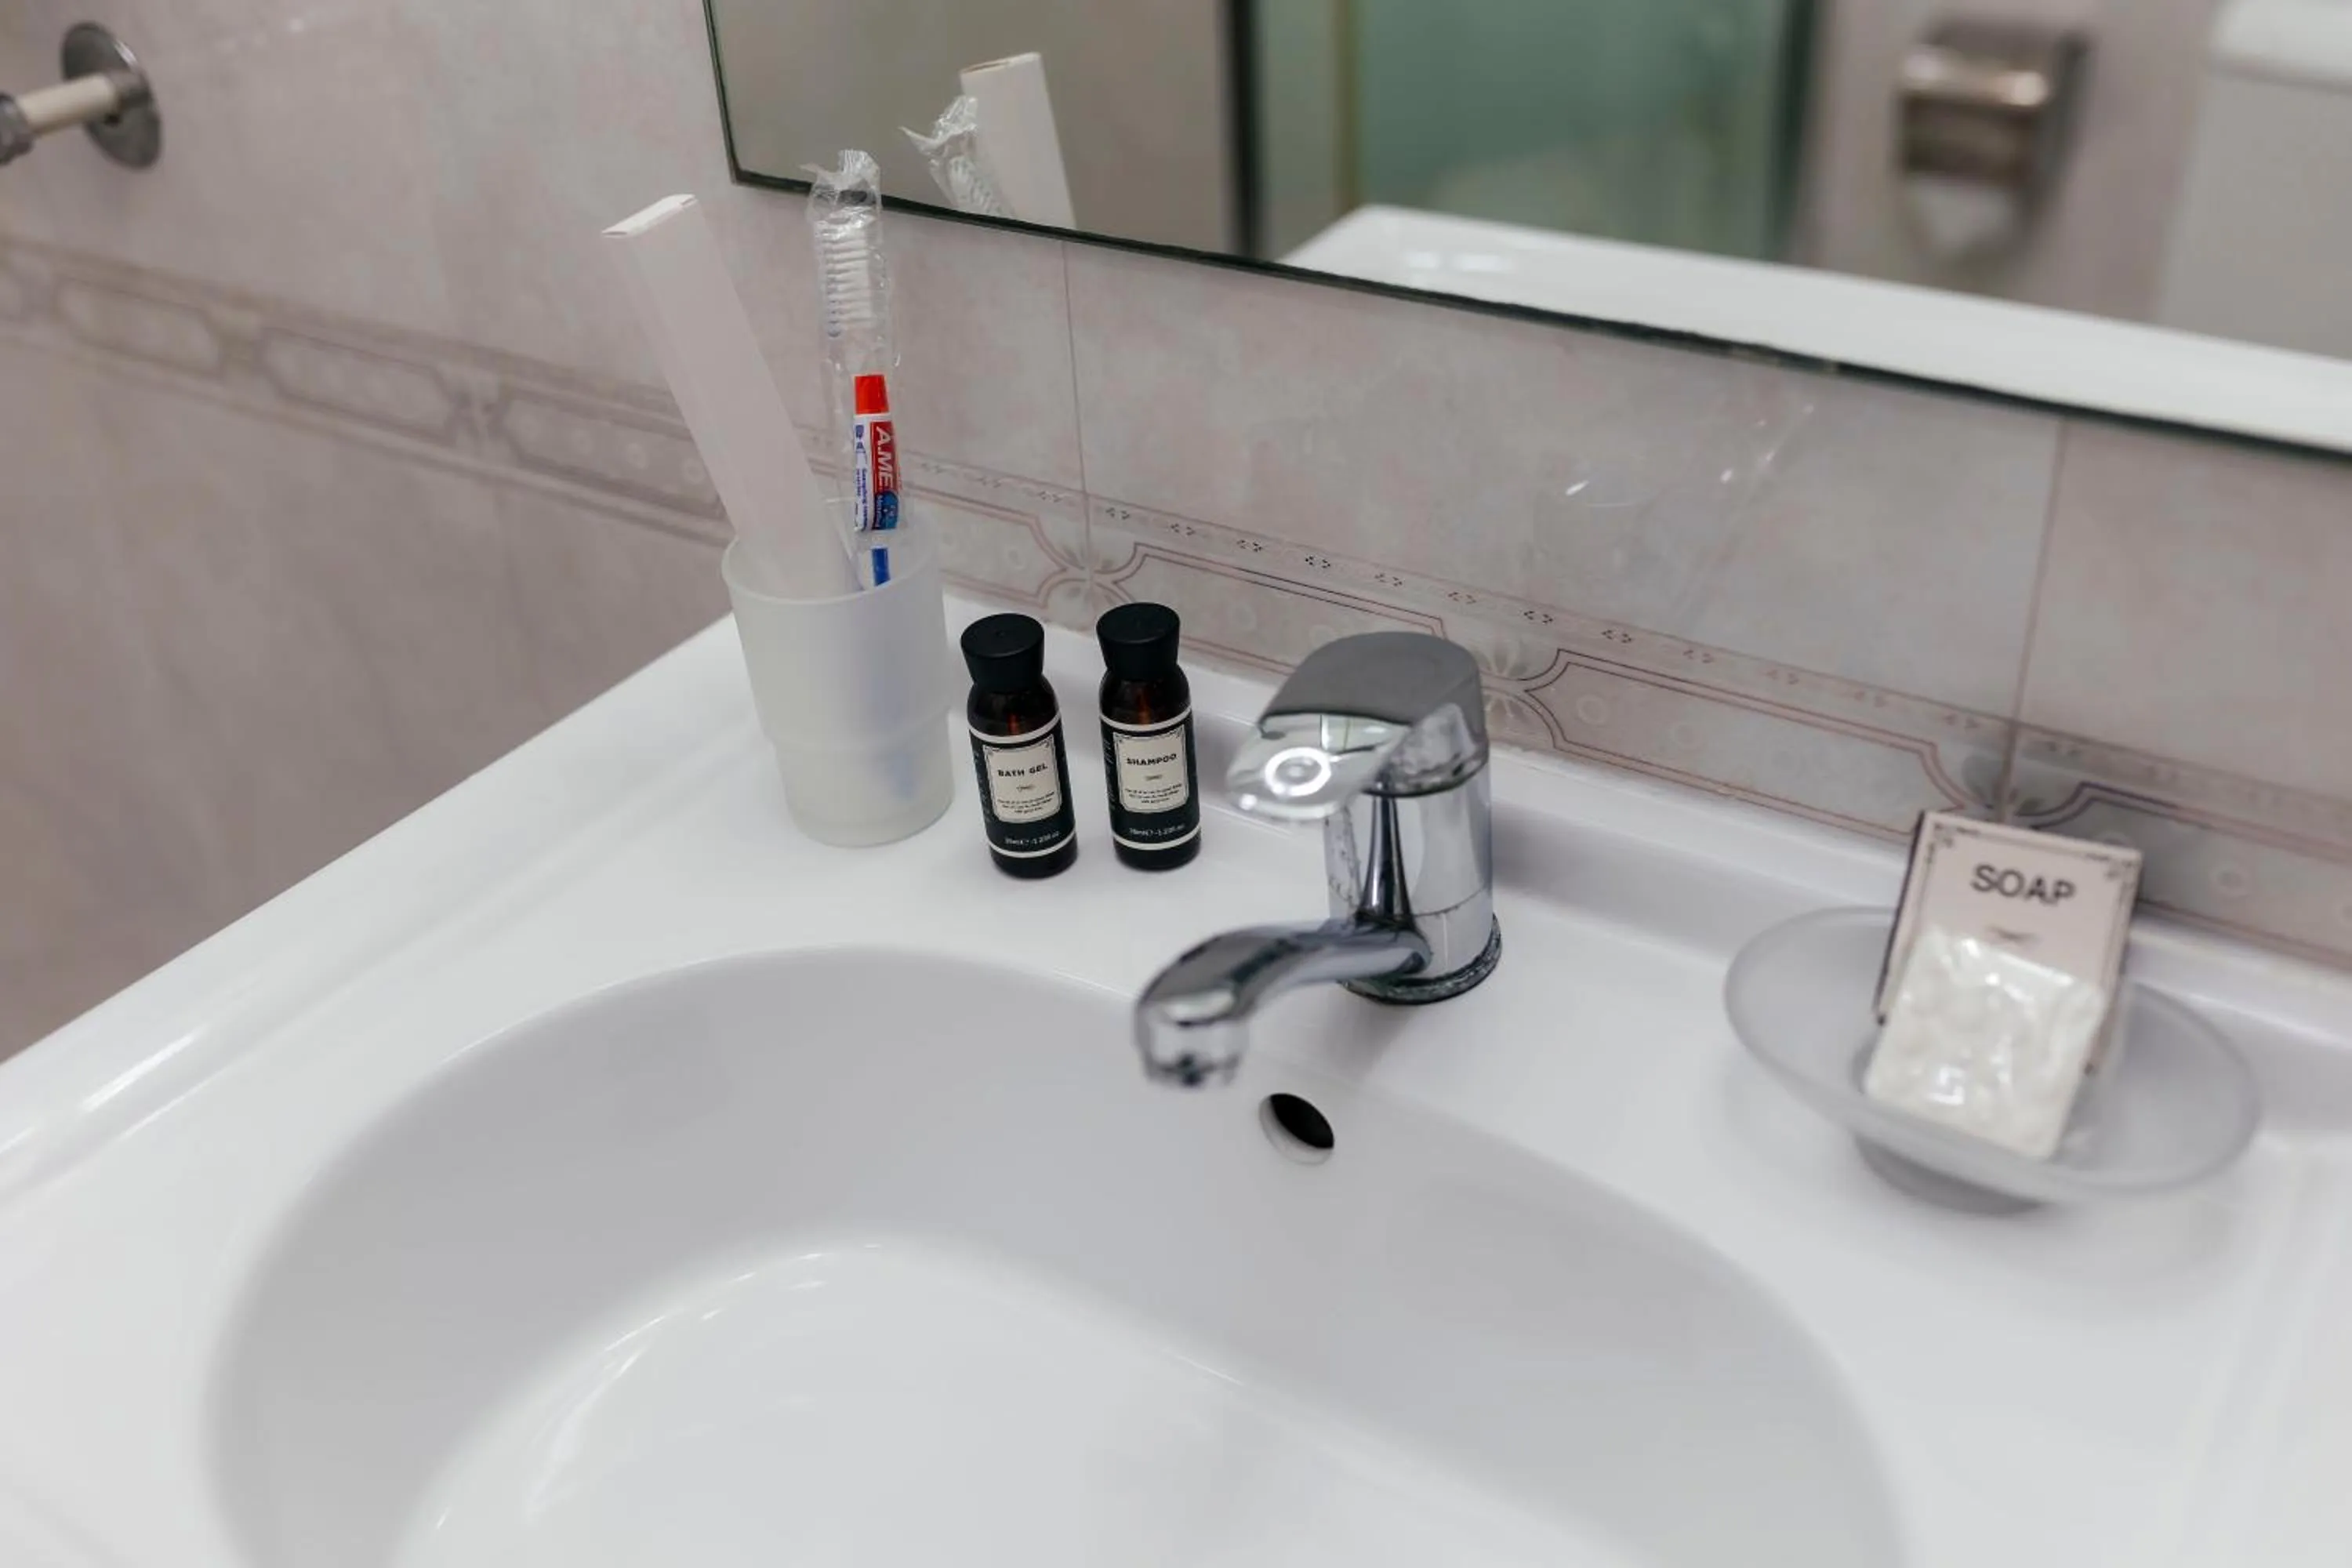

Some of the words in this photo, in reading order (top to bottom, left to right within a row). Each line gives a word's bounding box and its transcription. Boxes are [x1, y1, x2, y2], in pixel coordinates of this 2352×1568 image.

[876, 426, 894, 490] A.ME
[996, 768, 1025, 778] BATH
[1029, 762, 1048, 775] GEL
[1126, 753, 1178, 766] SHAMPOO
[1969, 862, 2077, 907] SOAP
